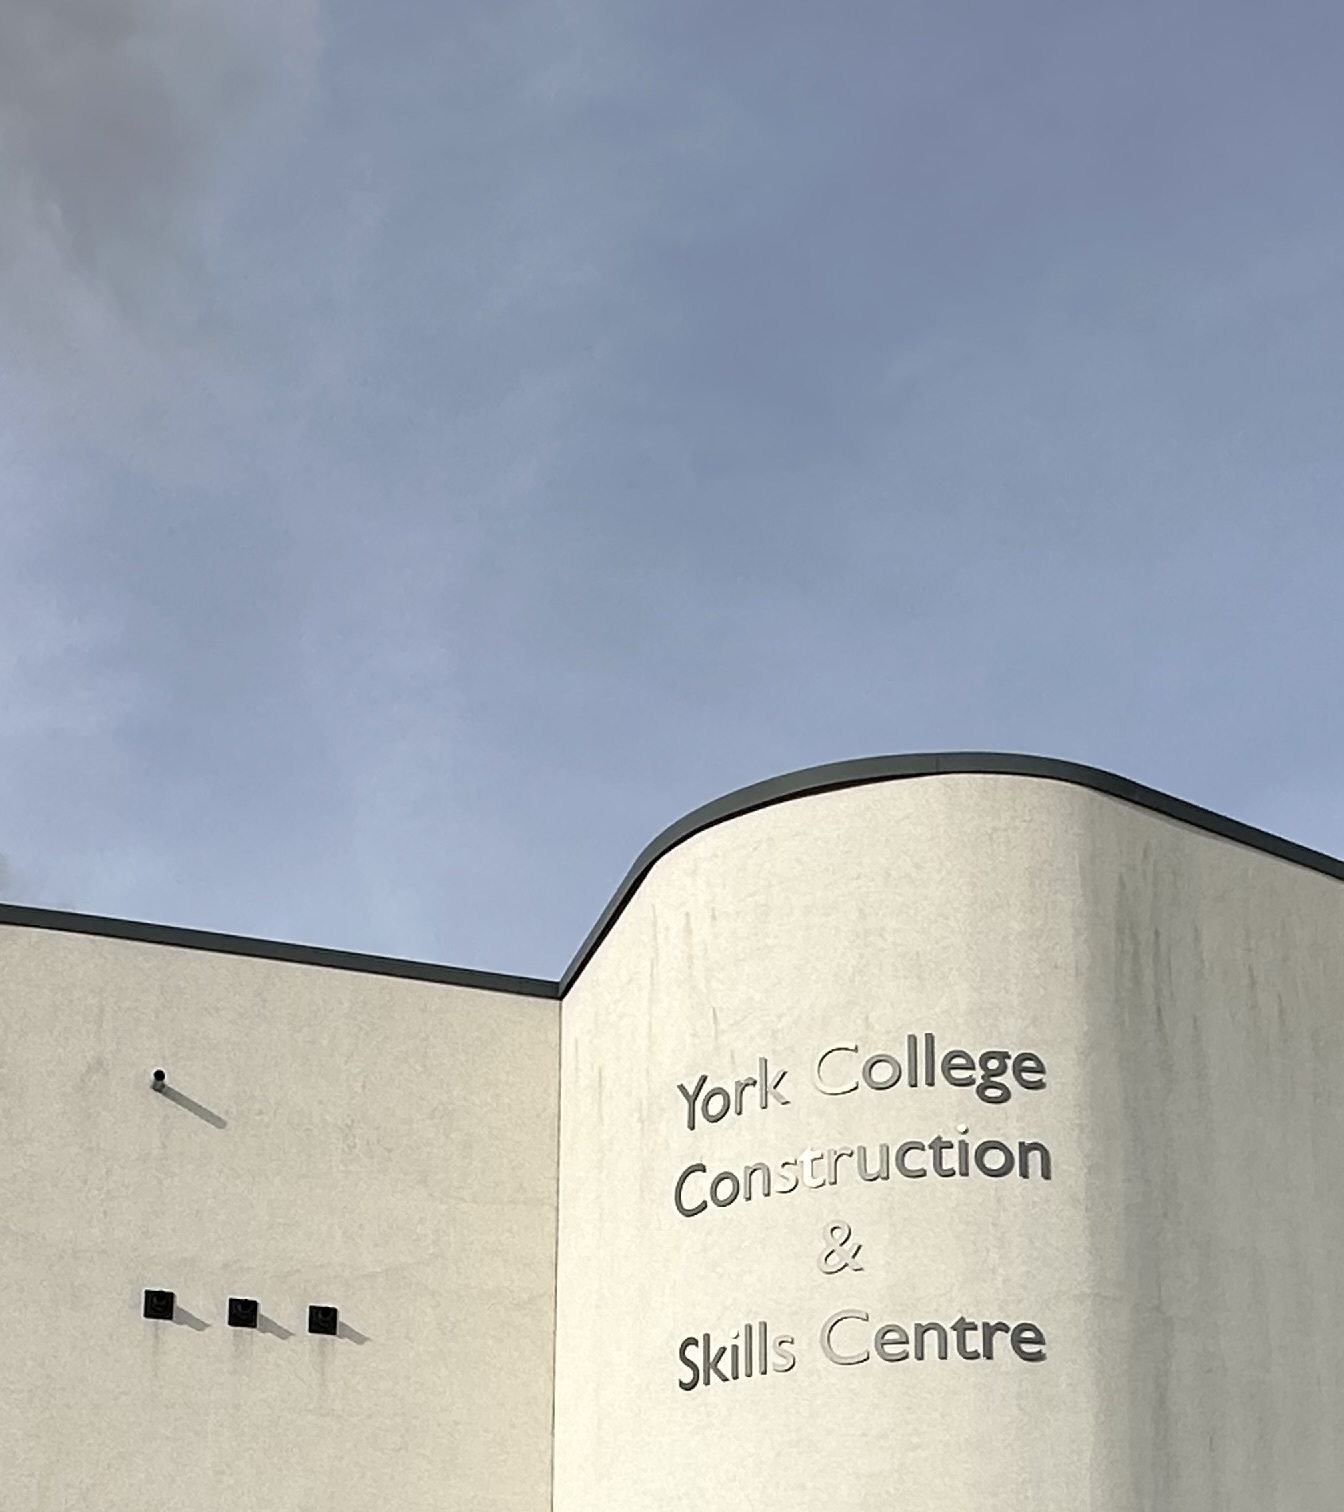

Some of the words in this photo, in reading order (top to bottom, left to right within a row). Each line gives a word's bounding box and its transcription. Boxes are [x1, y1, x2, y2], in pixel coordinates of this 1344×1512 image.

[677, 1056, 791, 1131] York
[812, 1032, 1047, 1105] College
[674, 1124, 1053, 1218] Construction
[817, 1219, 865, 1275] &
[678, 1320, 797, 1392] Skills
[819, 1309, 1047, 1365] Centre
